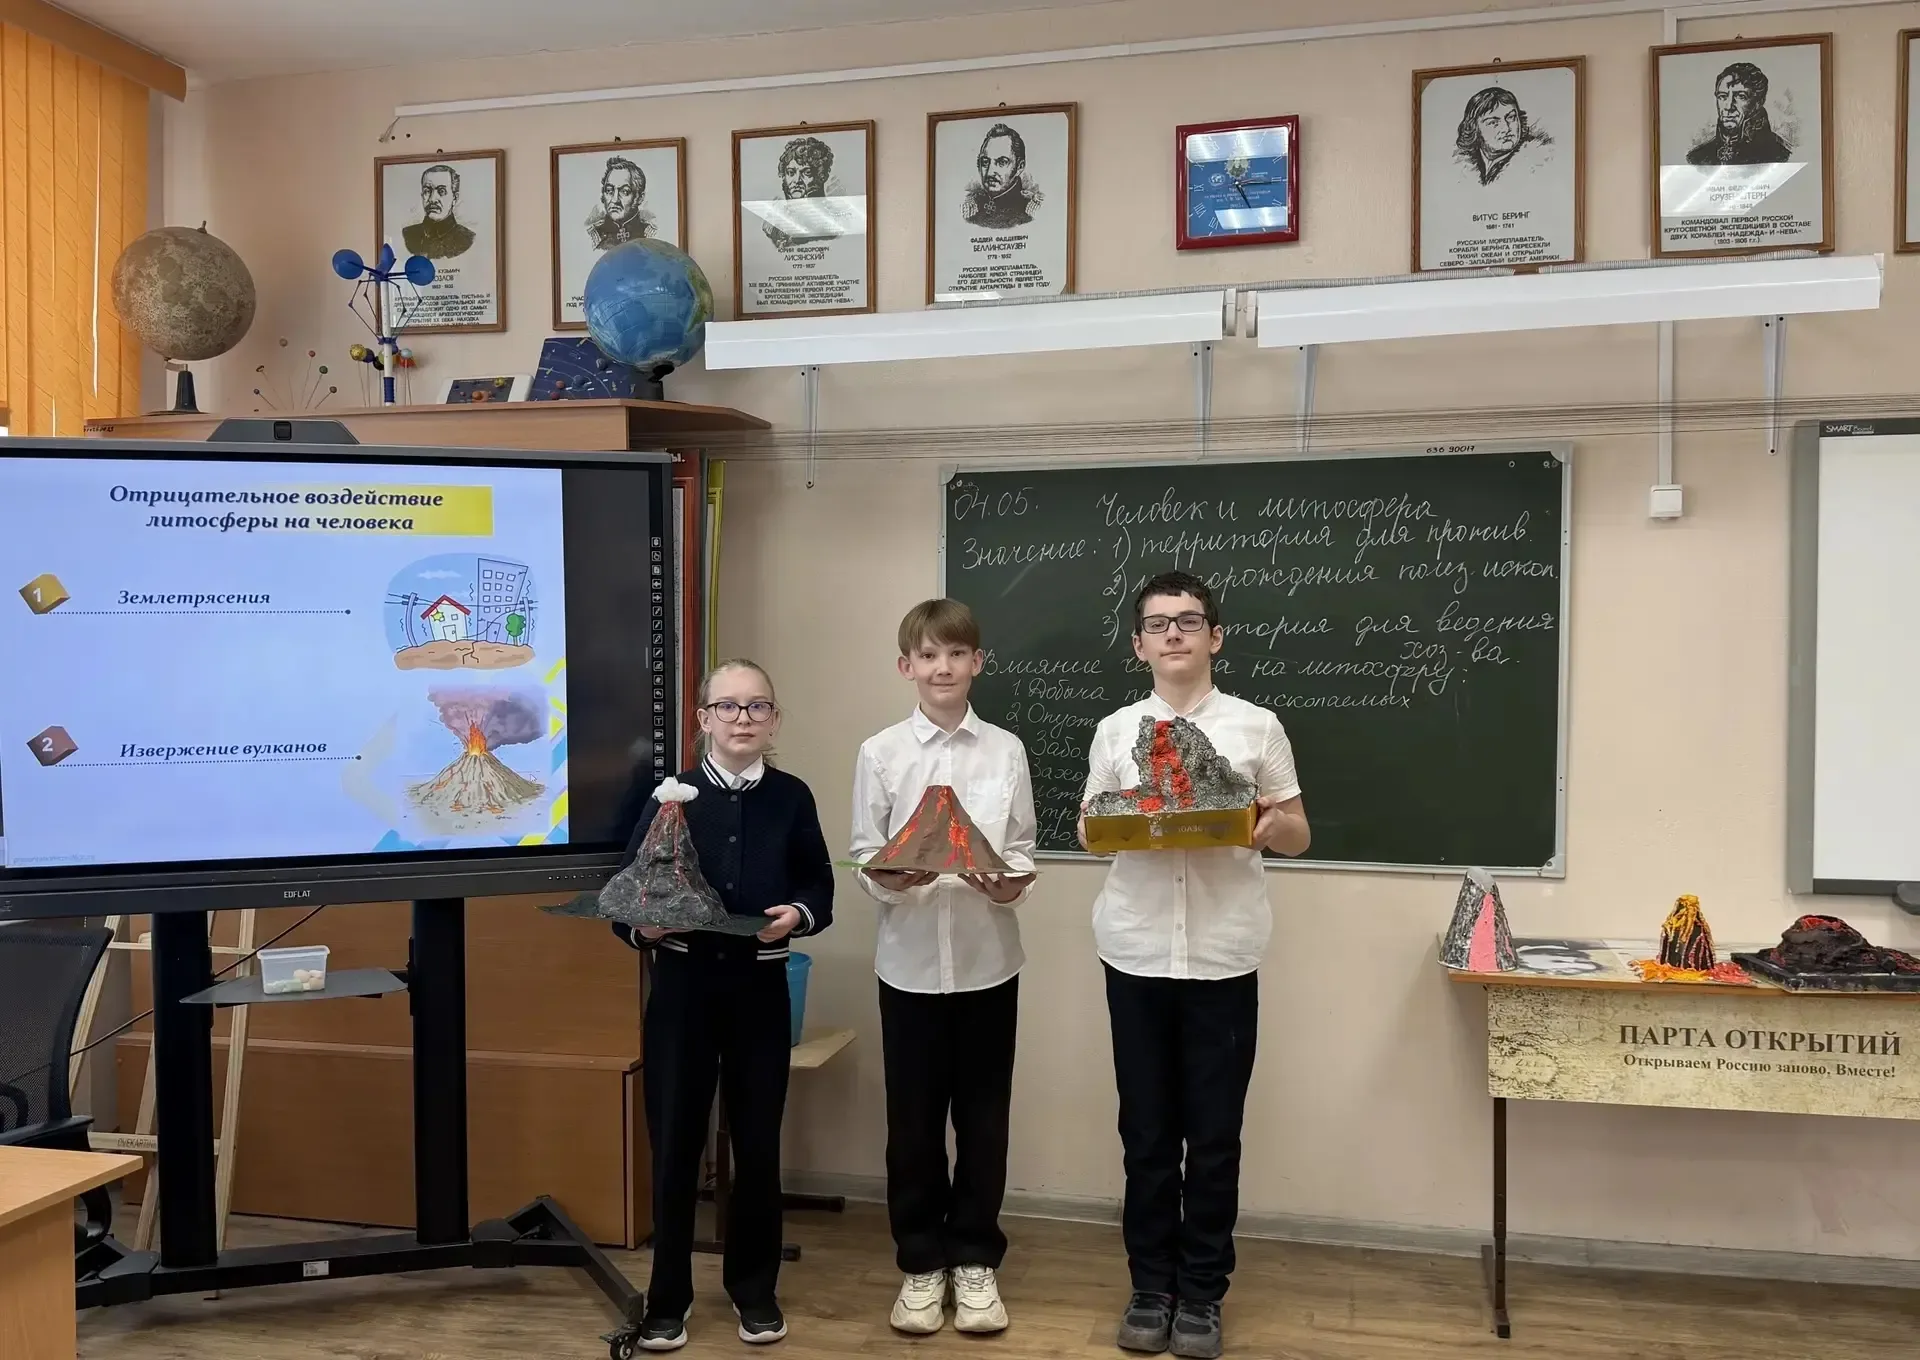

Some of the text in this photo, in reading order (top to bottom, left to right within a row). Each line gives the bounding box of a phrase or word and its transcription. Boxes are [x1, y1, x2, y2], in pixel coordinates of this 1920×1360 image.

[1473, 211, 1530, 222] ВИТУС БЕРИНГ
[1681, 218, 1728, 226] КОМАНДОВАЛ
[1762, 214, 1793, 222] РУССКОЙ
[1664, 225, 1717, 233] КРУГОСВЕТНОЙ
[1720, 222, 1770, 231] ЭКСПЕДИЦИЕЙ
[1691, 231, 1725, 239] КОРАБЛЕЙ
[973, 242, 1026, 252] БЕЛЛИНСГАУЗЕН
[1482, 244, 1510, 252] БЕРИНГА
[1512, 242, 1550, 250] ПЕРЕСЕКЛИ
[784, 253, 825, 261] ЛИСЯНСКИЙ
[1010, 269, 1042, 277] СТРАНИЦЕЙ
[109, 485, 444, 509] Отрицательное воздействие
[1097, 487, 1438, 533] Человек и литосфера
[146, 512, 414, 532] литосферы на человека
[1141, 525, 1335, 570] территория
[1355, 526, 1416, 563] для
[32, 587, 42, 602] 1
[117, 589, 270, 608] Землетрясения
[1355, 614, 1420, 646] для
[1437, 601, 1555, 641] ведения
[983, 648, 1103, 676] Влияние
[1251, 659, 1285, 678] на
[1029, 677, 1110, 700] Добыча
[1254, 692, 1412, 710] ископаемых
[41, 737, 54, 752] 2
[119, 741, 327, 760] Извержение вулканов
[284, 890, 311, 898] EDFLAT
[1619, 1024, 1901, 1056] ПАРТА ОТКРЫТИЙ
[1624, 1054, 1711, 1072] Открываем
[1717, 1057, 1771, 1075] Россию
[1836, 1062, 1896, 1079] Вместе!
